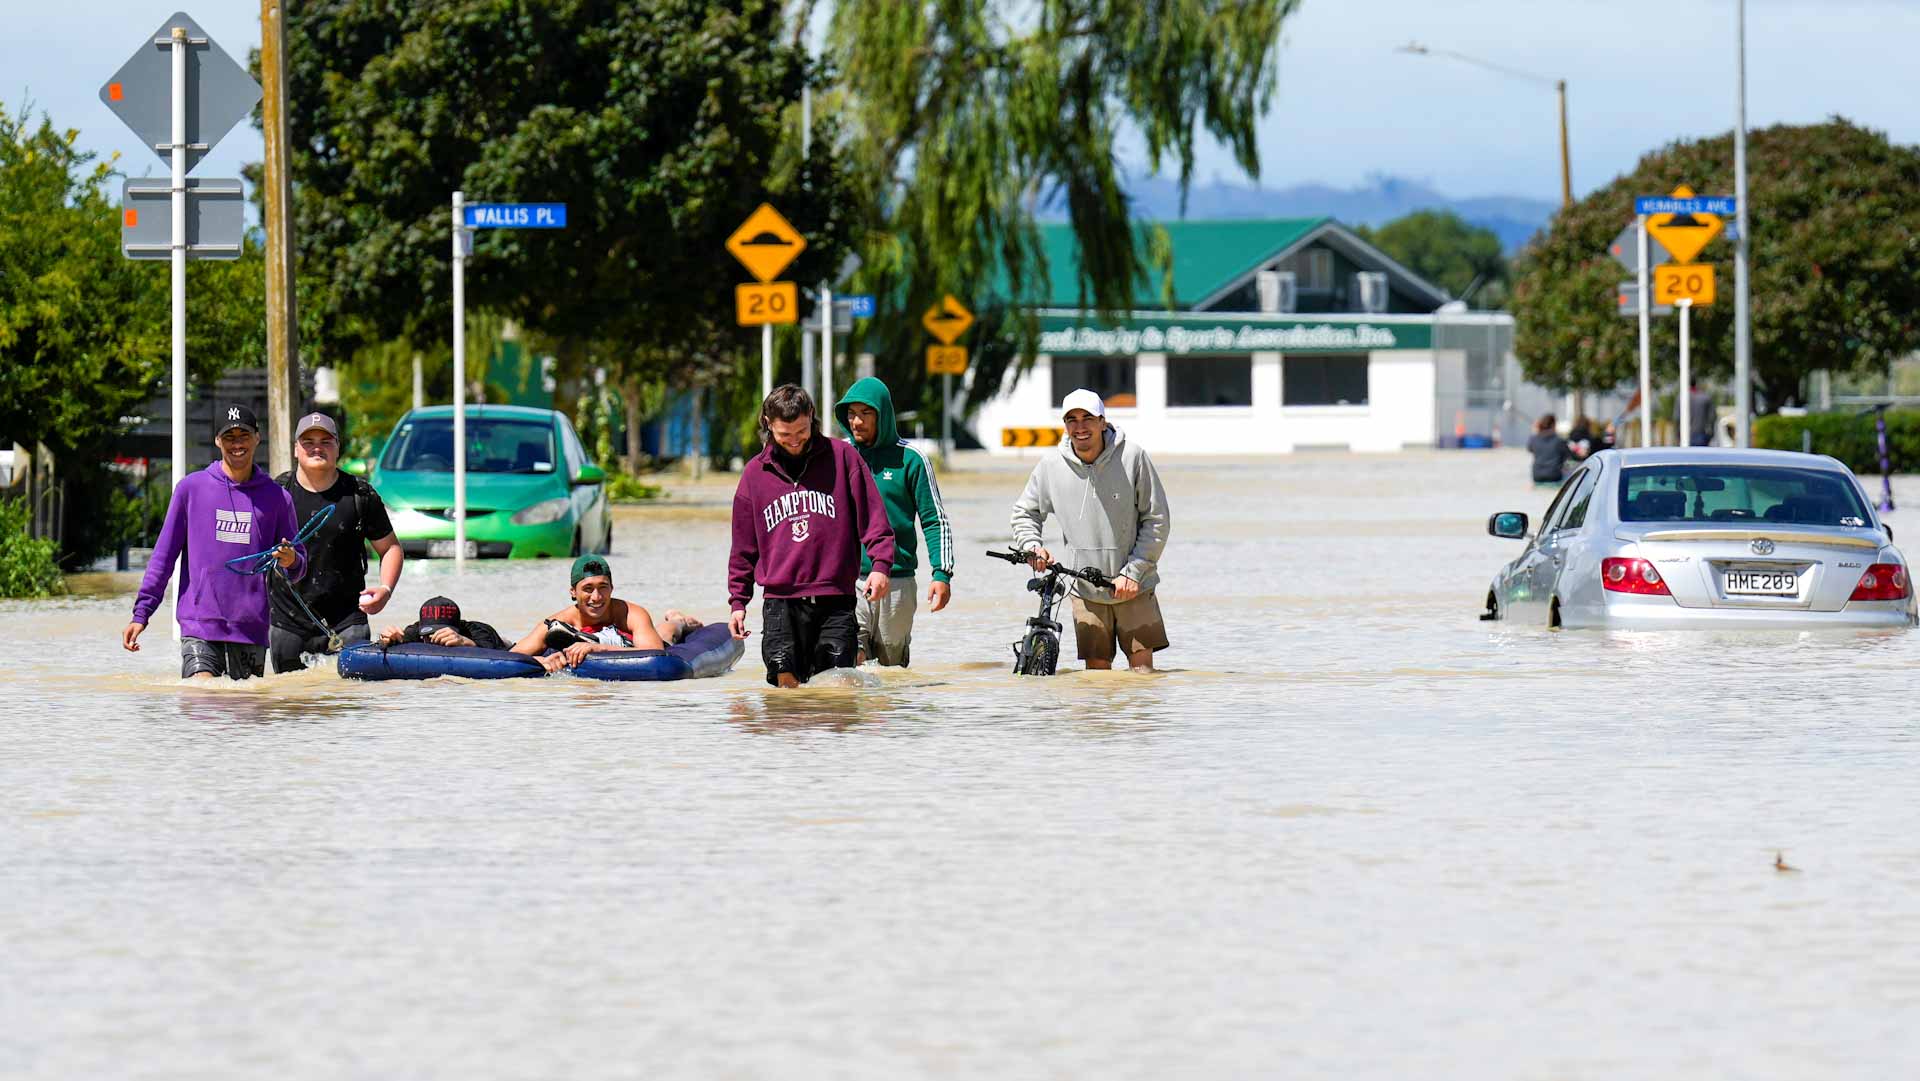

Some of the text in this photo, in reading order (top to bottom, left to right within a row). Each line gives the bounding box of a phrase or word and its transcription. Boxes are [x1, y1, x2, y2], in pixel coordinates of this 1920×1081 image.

[474, 208, 555, 224] WALLIS PL
[1667, 275, 1703, 294] 20
[750, 293, 786, 314] 20
[311, 415, 321, 425] P
[763, 490, 836, 532] HAMPTONS
[1727, 572, 1794, 590] HME209
